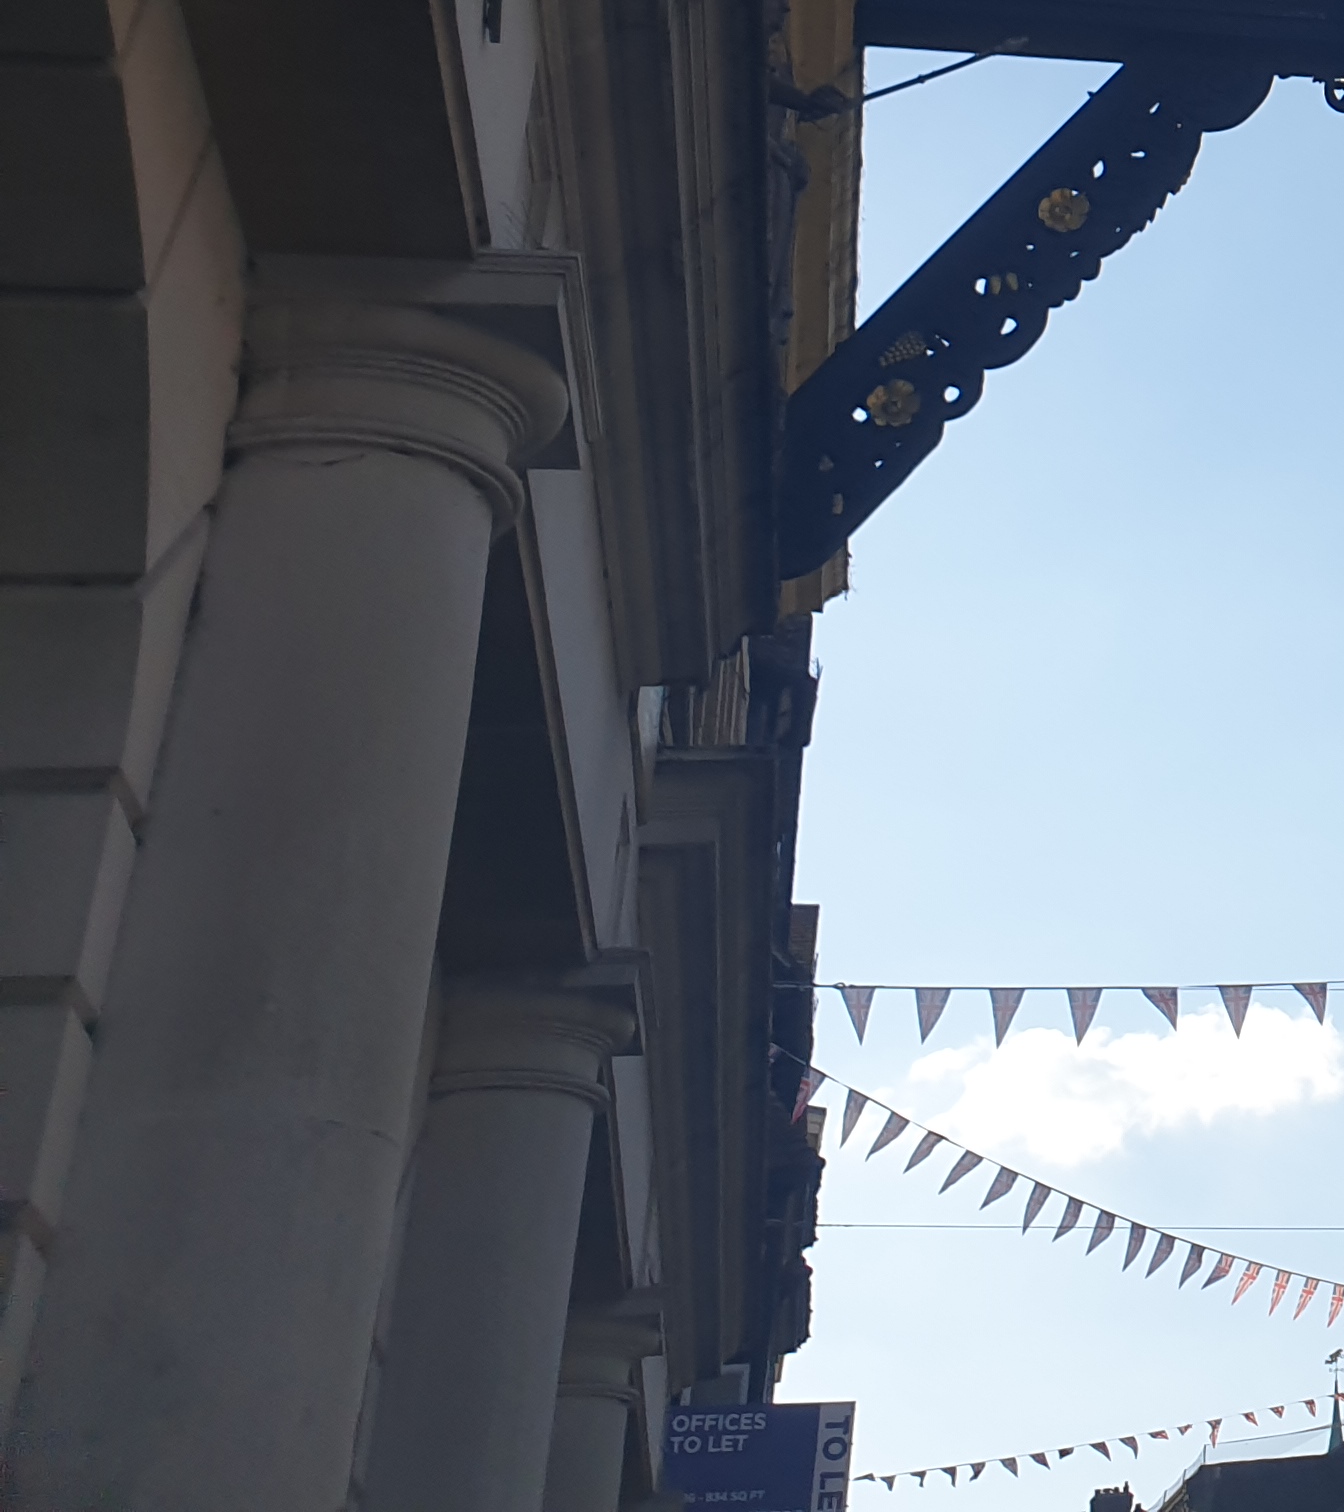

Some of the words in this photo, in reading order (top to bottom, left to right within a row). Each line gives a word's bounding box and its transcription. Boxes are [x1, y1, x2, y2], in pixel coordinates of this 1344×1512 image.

[671, 1412, 767, 1432] OFFICES
[669, 1435, 702, 1454] TO
[707, 1434, 749, 1453] LET
[822, 1415, 851, 1461] TO
[749, 1489, 766, 1501] FT
